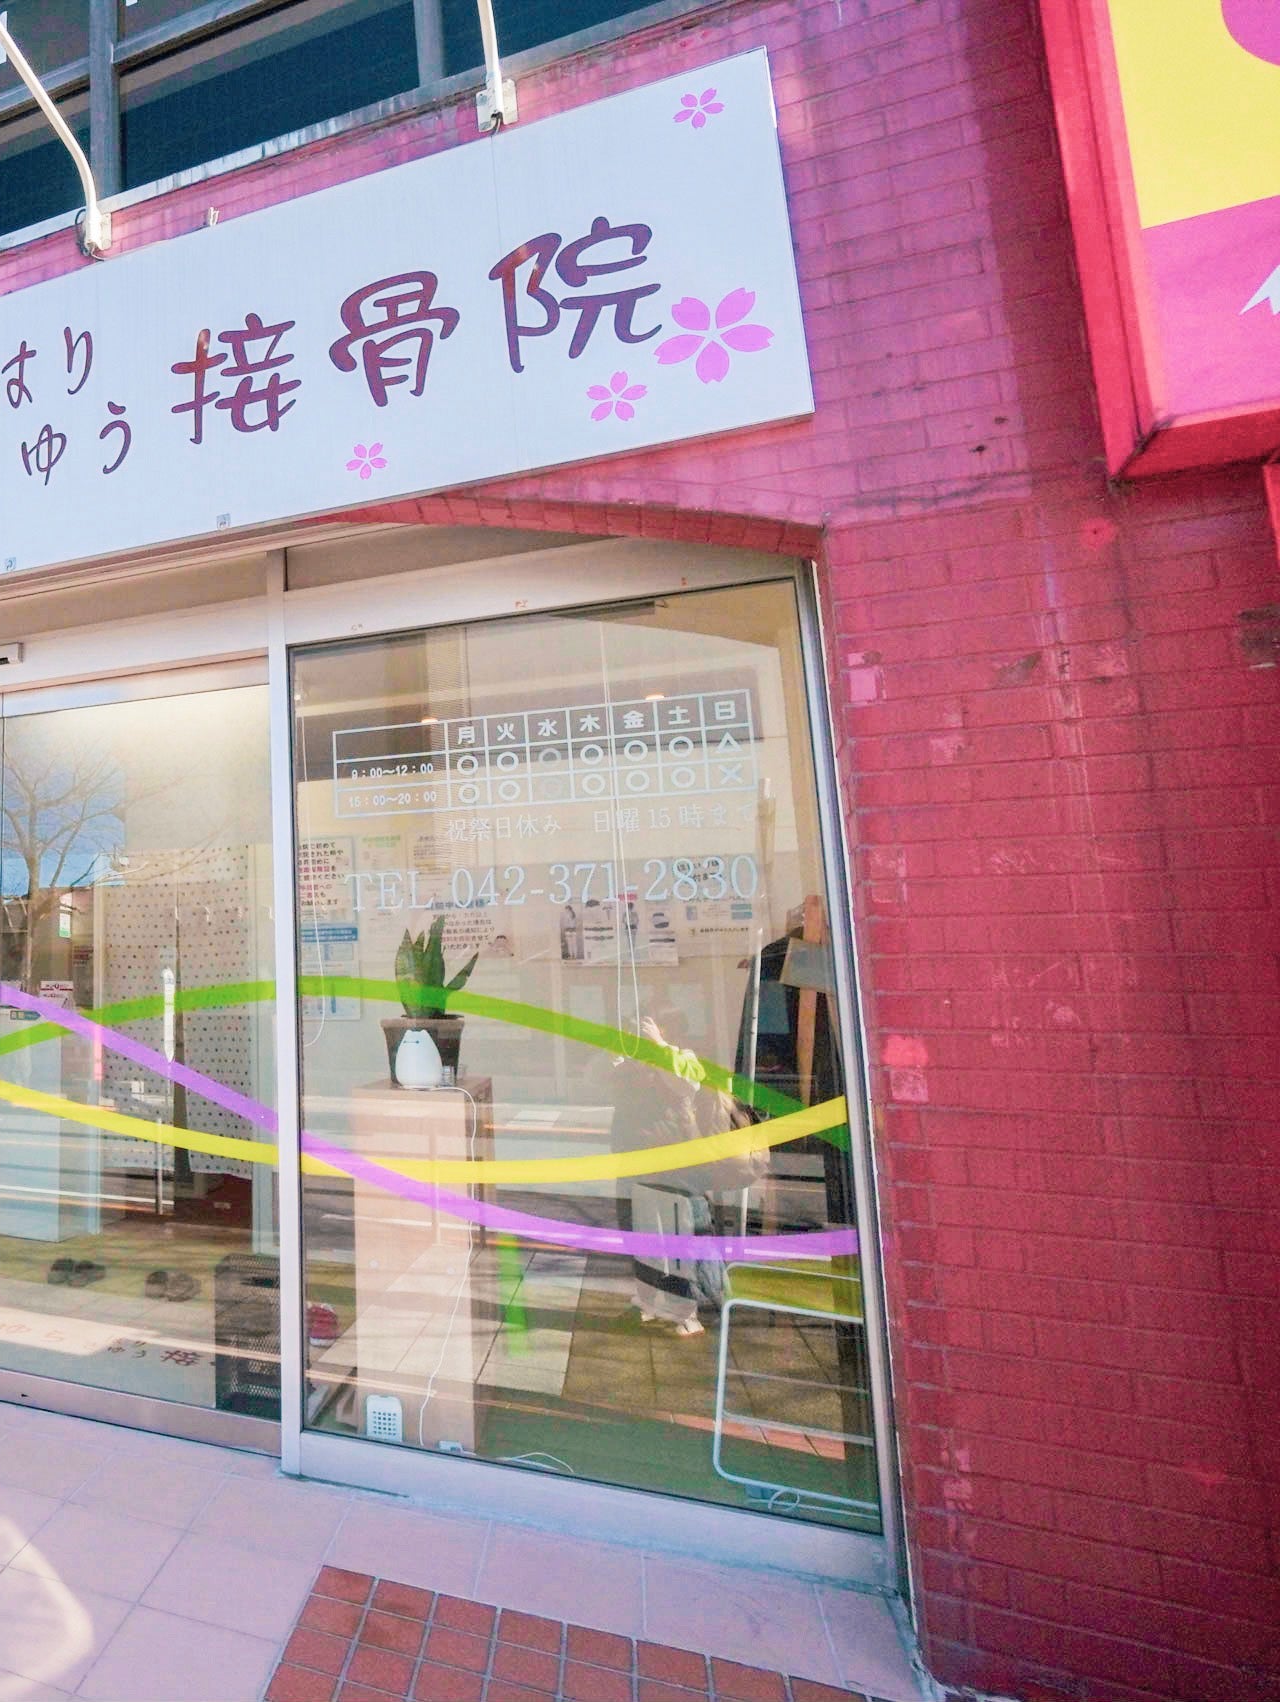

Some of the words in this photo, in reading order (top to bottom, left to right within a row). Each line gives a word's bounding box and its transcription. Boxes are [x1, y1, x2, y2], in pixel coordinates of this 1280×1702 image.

[171, 216, 663, 445] 接骨院
[457, 726, 476, 745] 月
[496, 722, 516, 741] 火
[537, 718, 558, 737] 水
[579, 714, 601, 733] 木
[623, 710, 645, 729] 金
[668, 706, 691, 725] 土
[714, 700, 737, 720] 日
[447, 814, 562, 841] 祝祭日休み
[343, 869, 435, 913] TEL
[451, 854, 758, 908] 042-371-2830
